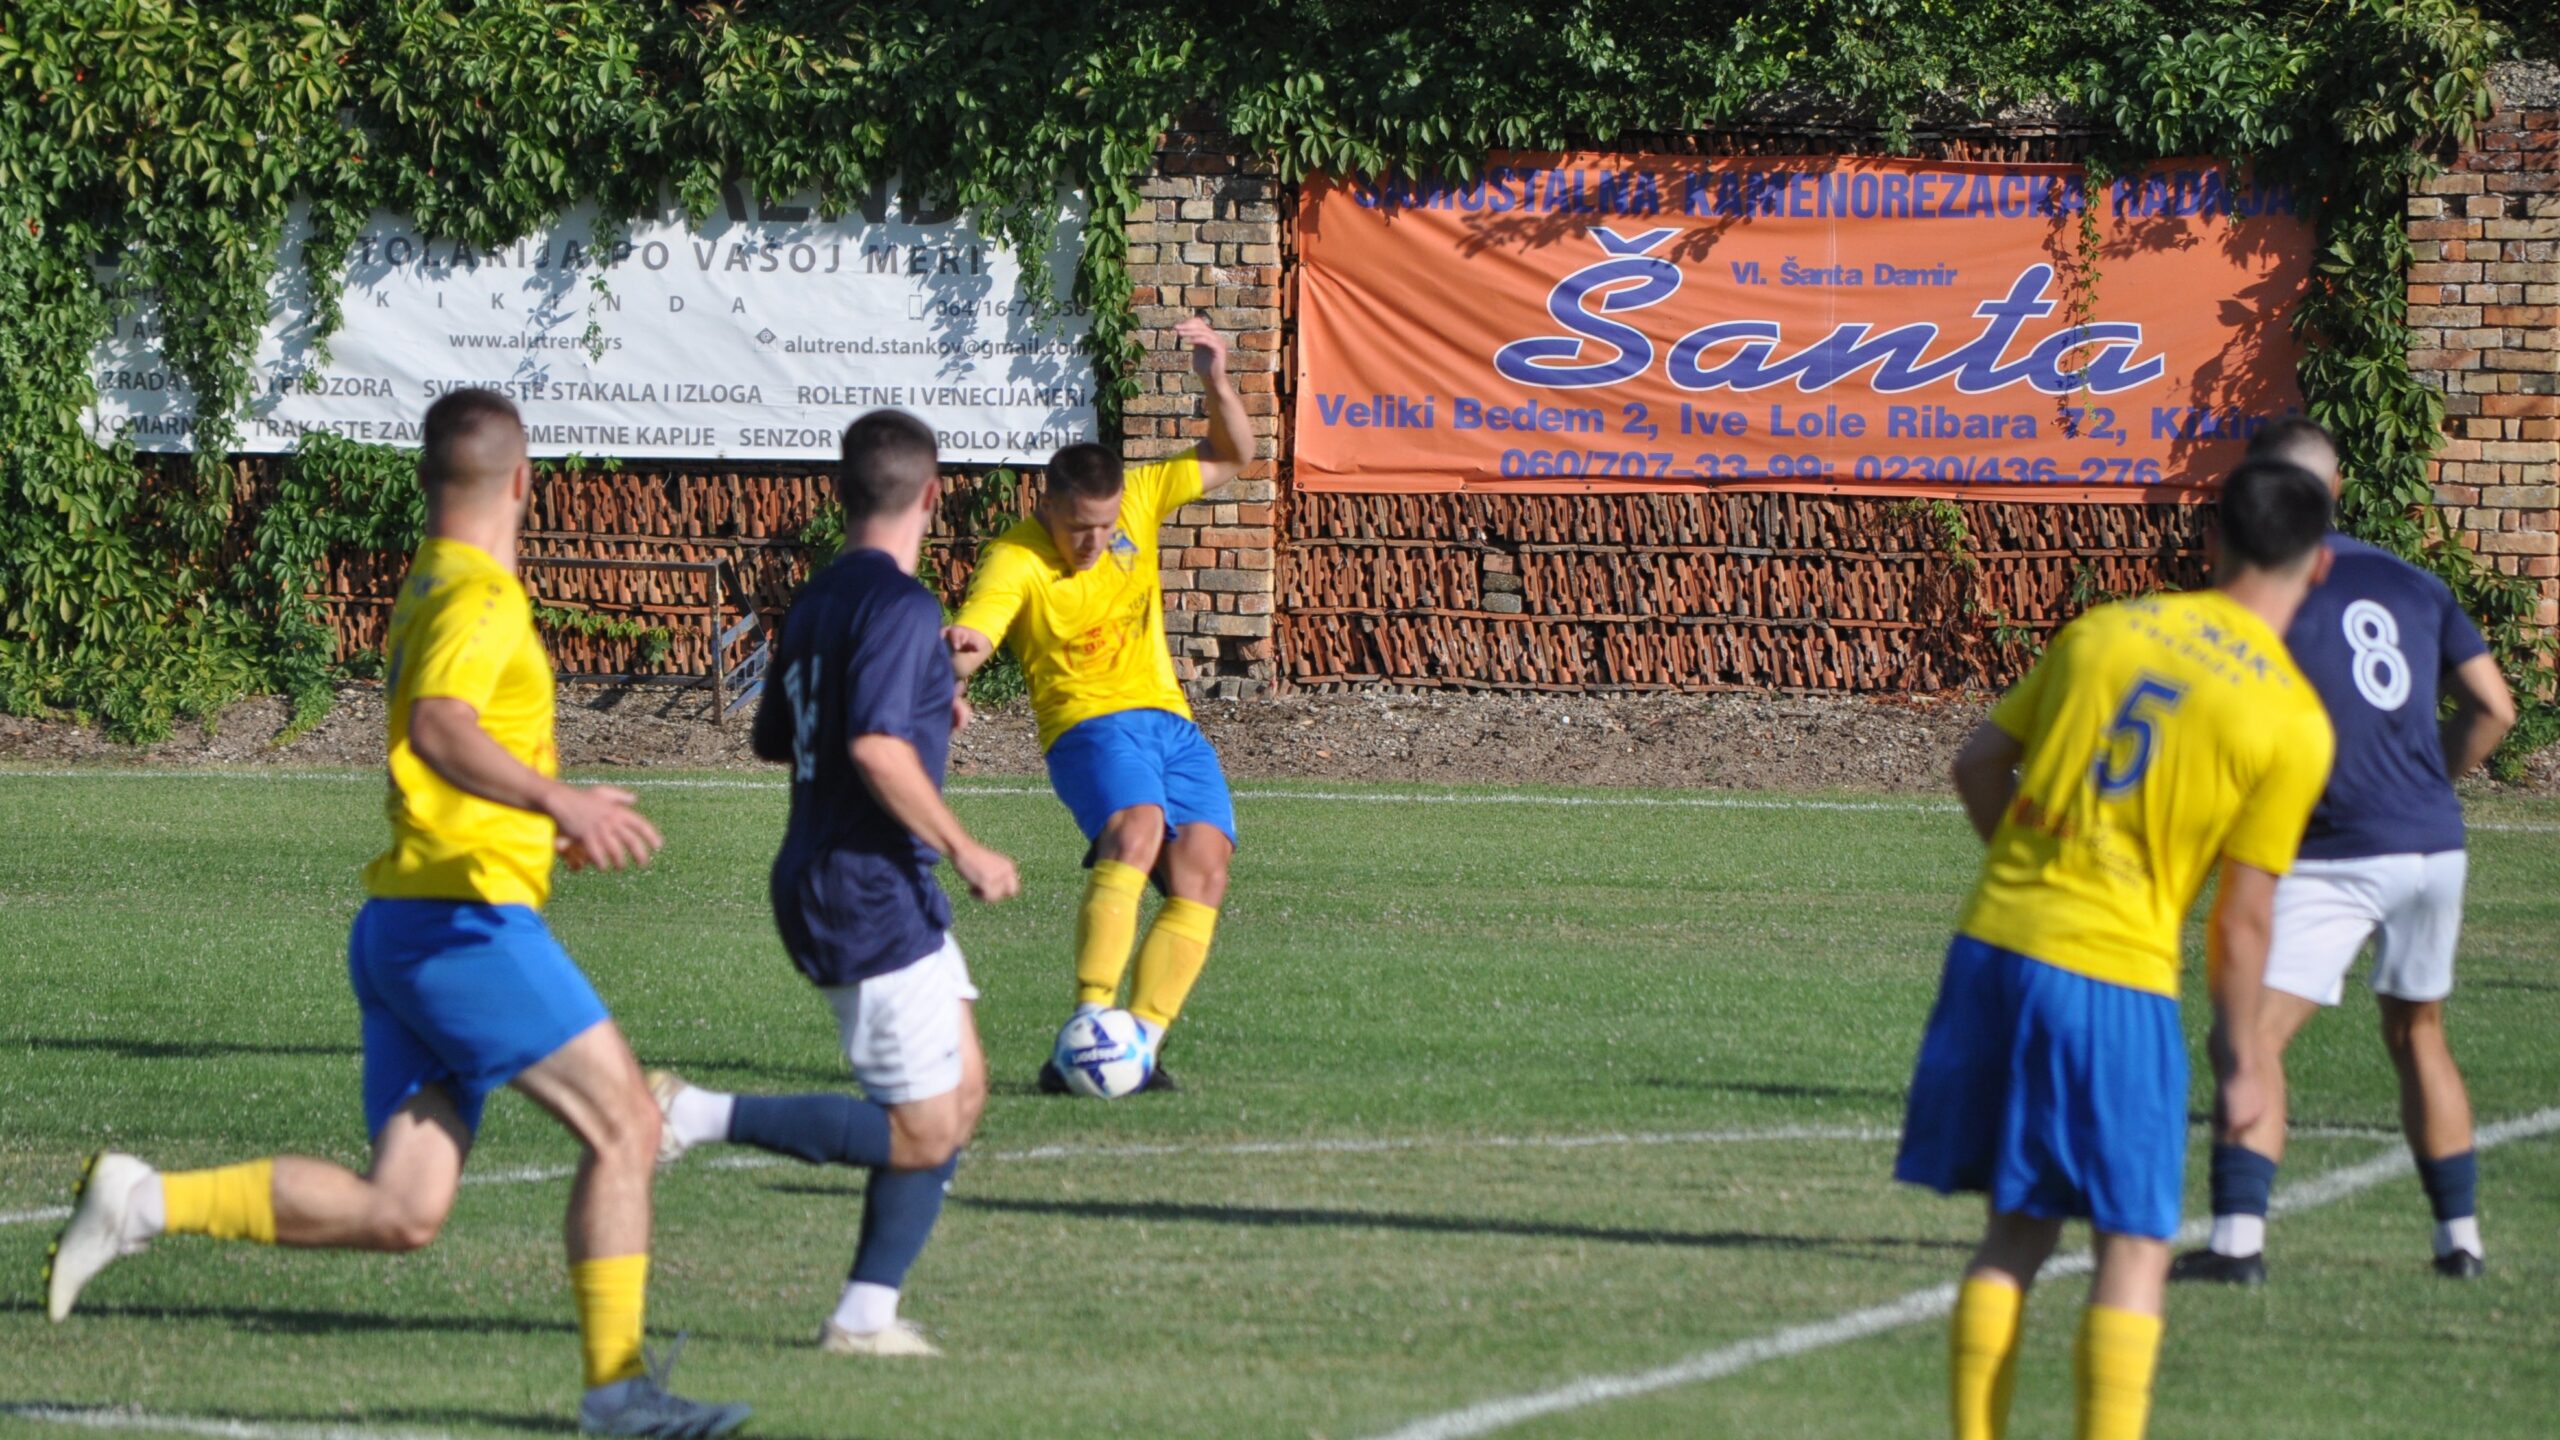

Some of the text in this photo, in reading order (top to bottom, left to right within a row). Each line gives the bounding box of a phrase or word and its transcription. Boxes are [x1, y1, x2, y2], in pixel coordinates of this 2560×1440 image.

[354, 236, 979, 275] TOLARIJA PO VAŠOJ MERI
[1780, 257, 1863, 286] Šanta
[1874, 263, 1957, 286] Damir
[1494, 227, 2165, 394] Šanta
[551, 382, 656, 402] STAKALA
[676, 384, 763, 403] IZLOGA
[798, 386, 903, 406] ROLETNE
[921, 387, 1085, 407] VENECIJANERI
[255, 417, 373, 439] TRAKASTE
[1316, 395, 1435, 429] Veliki
[1454, 398, 1605, 434] Bedem
[1622, 403, 1659, 441] 2,
[1681, 403, 1748, 436] Ive
[1769, 405, 1866, 438] Lole
[1887, 407, 2037, 440] Ribara
[636, 426, 715, 446] KAPIJE
[739, 428, 833, 447] SENZOR
[2342, 598, 2411, 712] 8
[2093, 671, 2185, 797] 5
